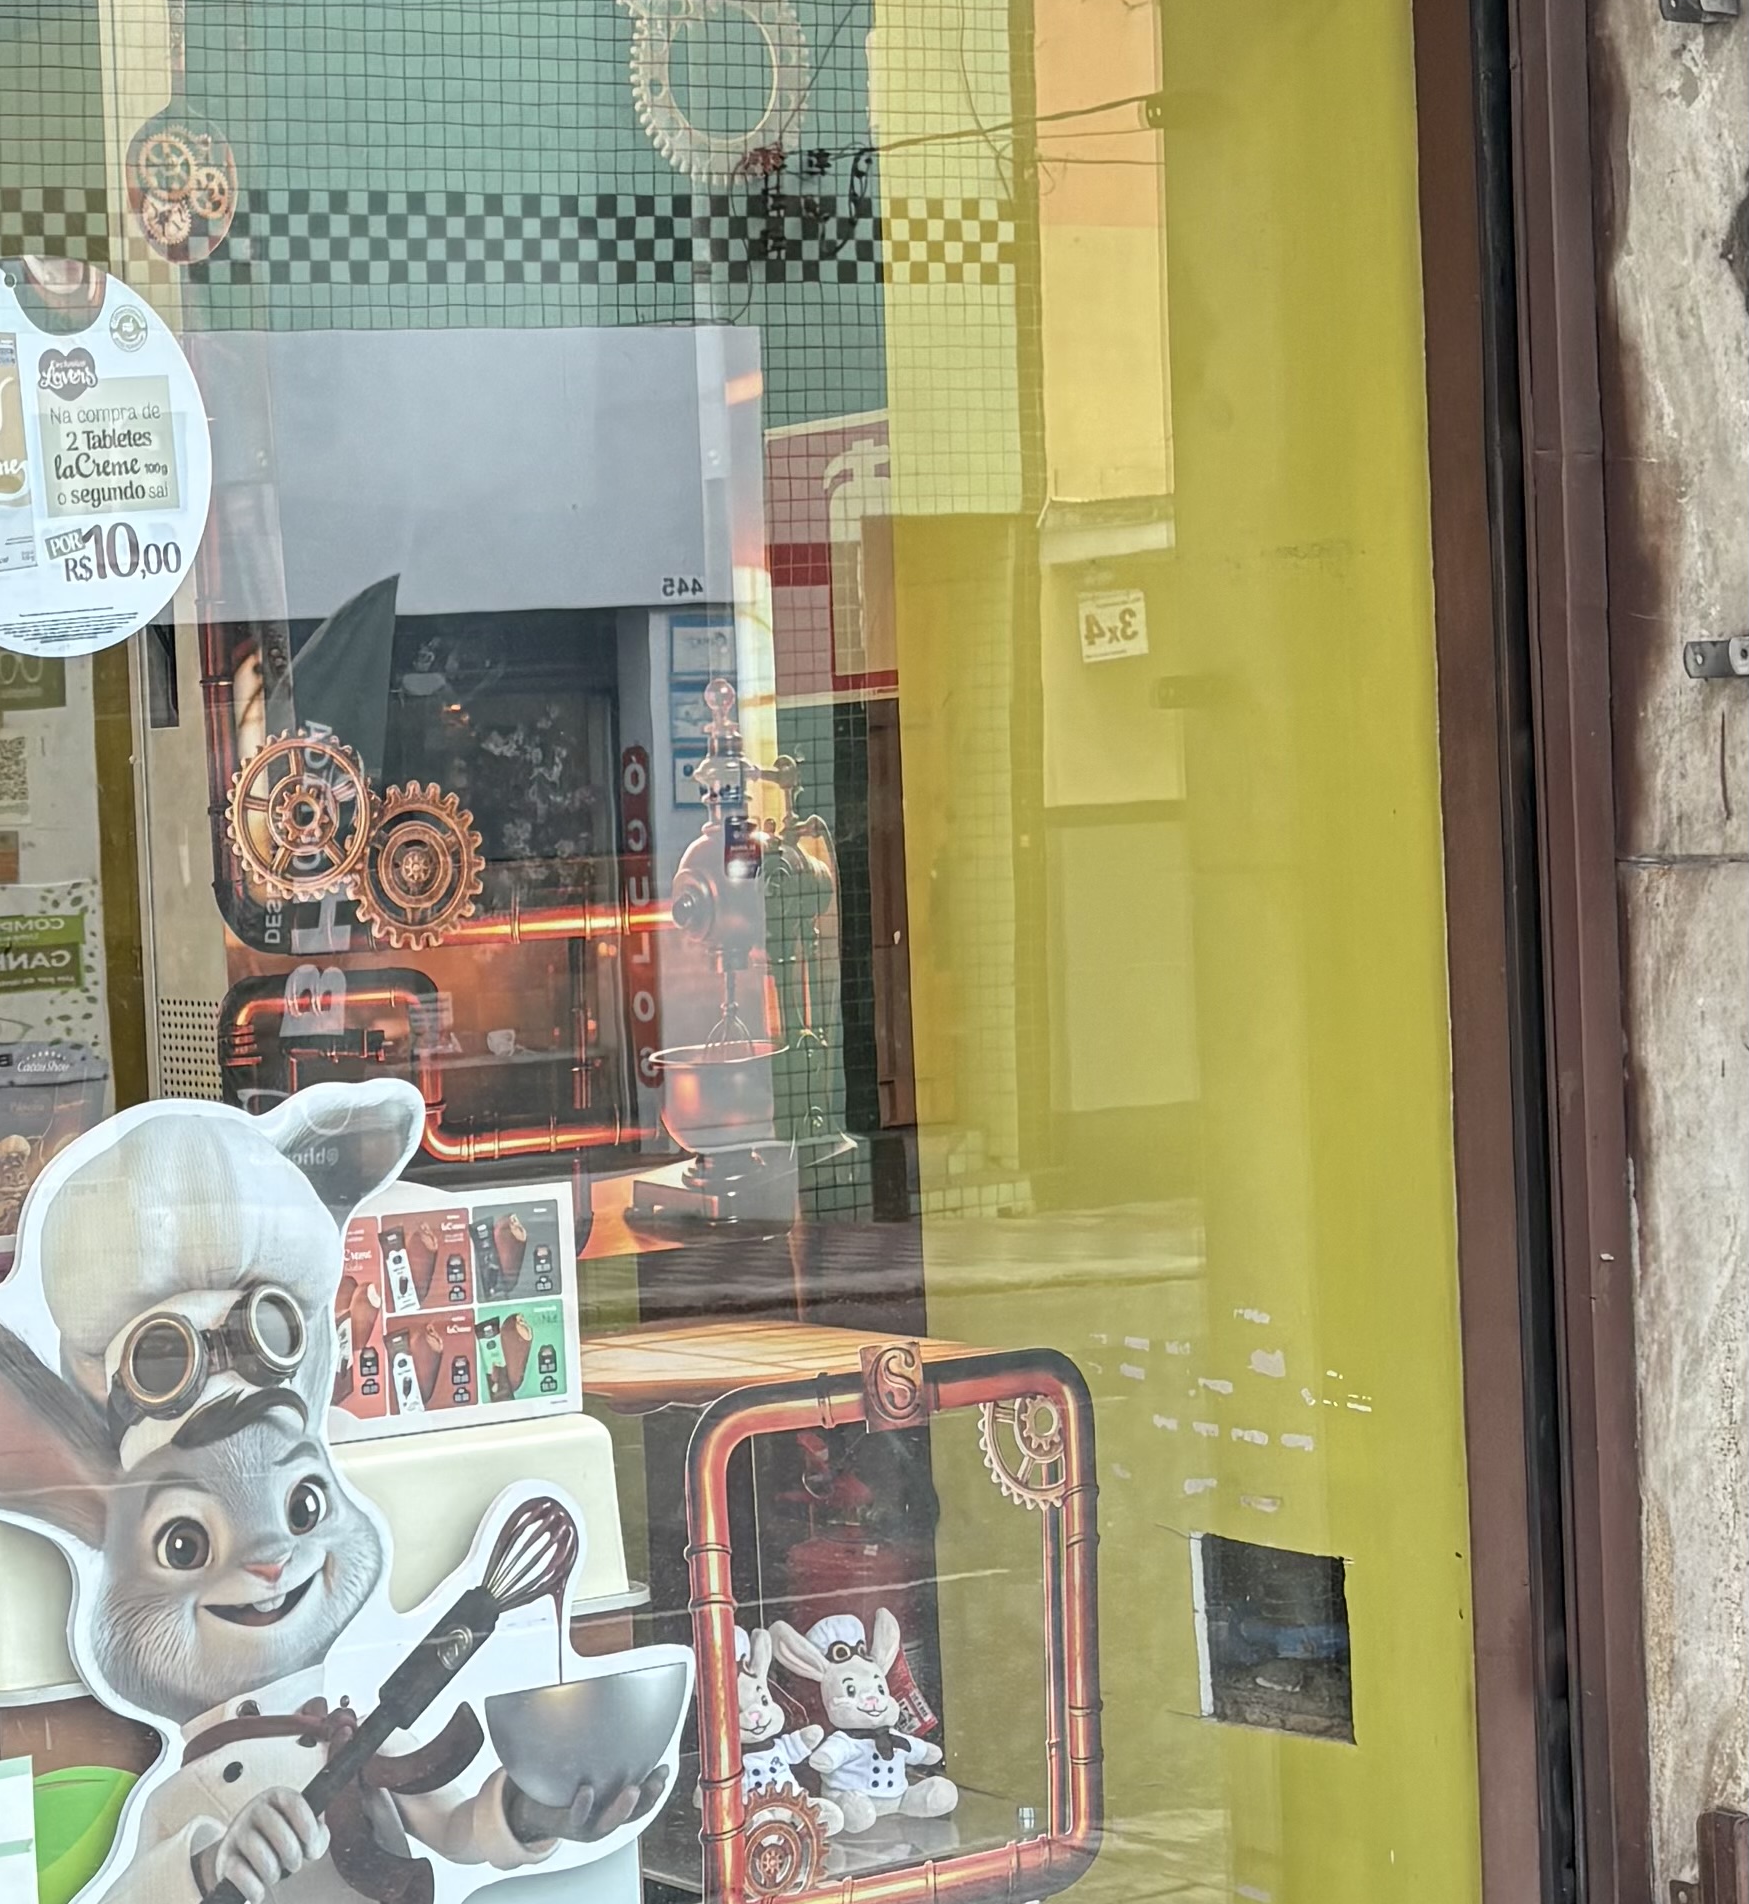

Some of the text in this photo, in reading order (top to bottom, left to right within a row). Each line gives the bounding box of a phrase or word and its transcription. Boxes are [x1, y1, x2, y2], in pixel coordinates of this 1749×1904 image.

[40, 363, 96, 389] Lovers
[50, 402, 161, 425] Na compra de
[66, 428, 152, 451] 2 Tabletes
[57, 480, 168, 508] o segundo sai
[50, 531, 83, 556] POR
[64, 555, 93, 582] R$
